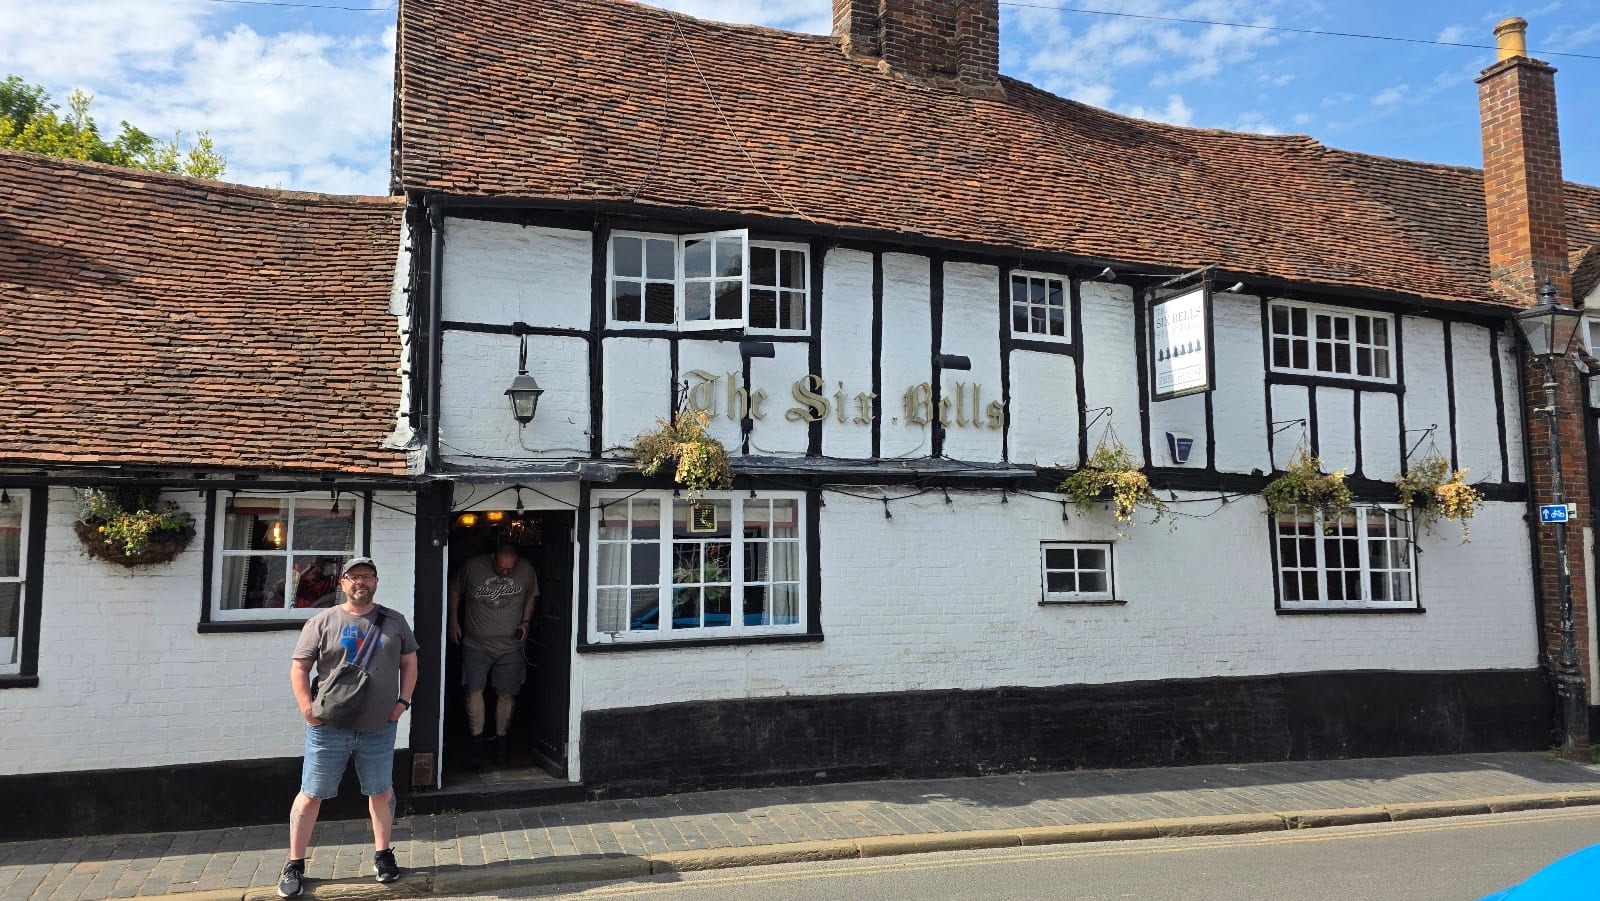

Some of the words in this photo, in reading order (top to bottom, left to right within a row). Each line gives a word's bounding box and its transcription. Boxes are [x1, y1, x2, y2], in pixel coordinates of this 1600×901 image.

[1156, 315, 1169, 328] SIX
[1172, 306, 1201, 324] BELLS
[684, 369, 768, 421] The
[785, 374, 878, 424] Six
[902, 380, 1006, 430] Bells
